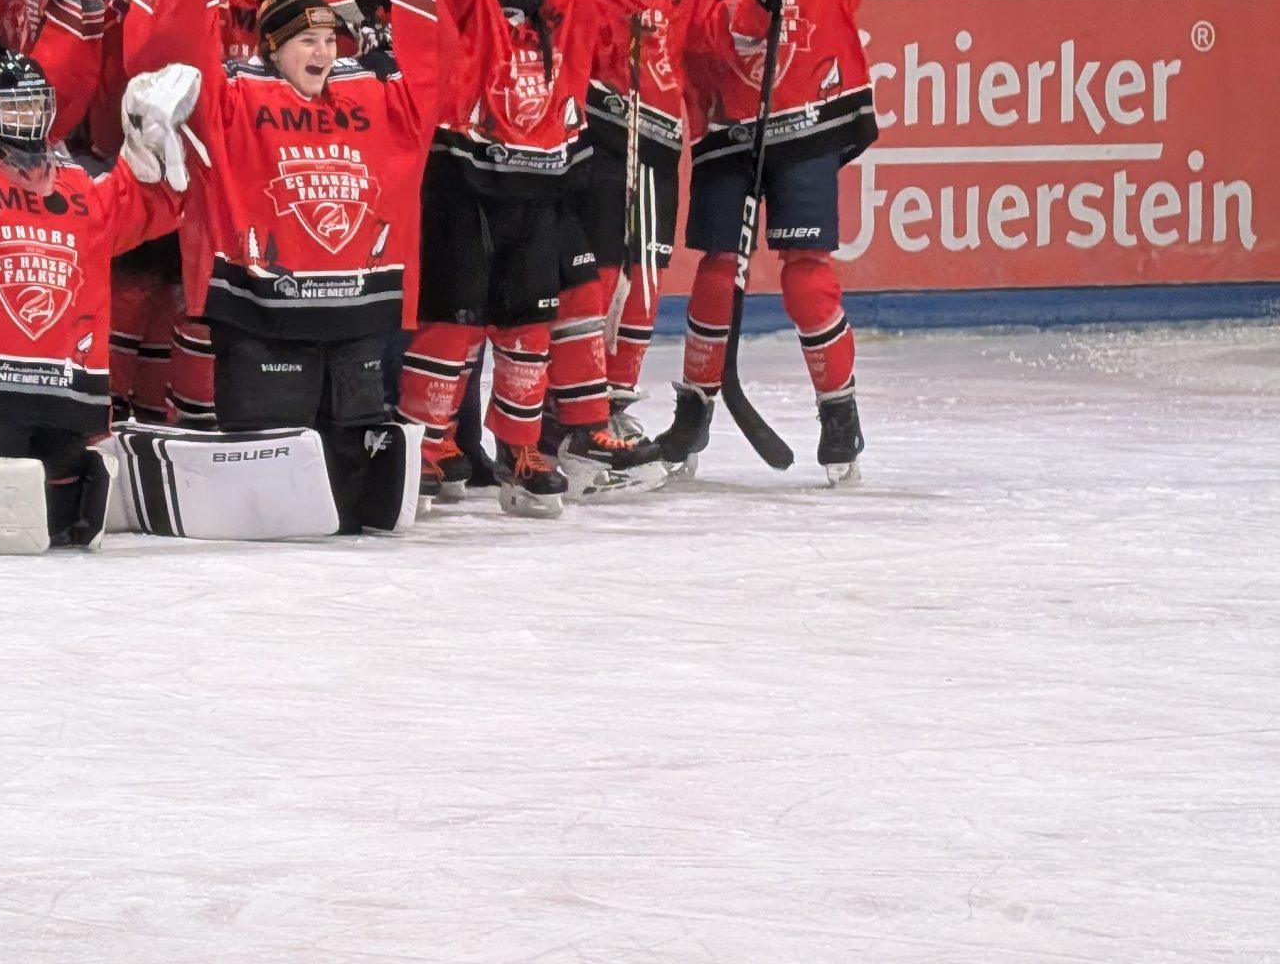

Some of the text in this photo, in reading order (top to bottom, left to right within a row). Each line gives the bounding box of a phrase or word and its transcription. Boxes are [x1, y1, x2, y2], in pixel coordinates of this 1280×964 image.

[858, 30, 1182, 135] chierker
[255, 104, 371, 135] AMEOS
[830, 143, 1258, 262] Feuerstein
[734, 195, 757, 291] CCM
[4, 268, 67, 288] FALKEN
[212, 446, 291, 463] BAUER
